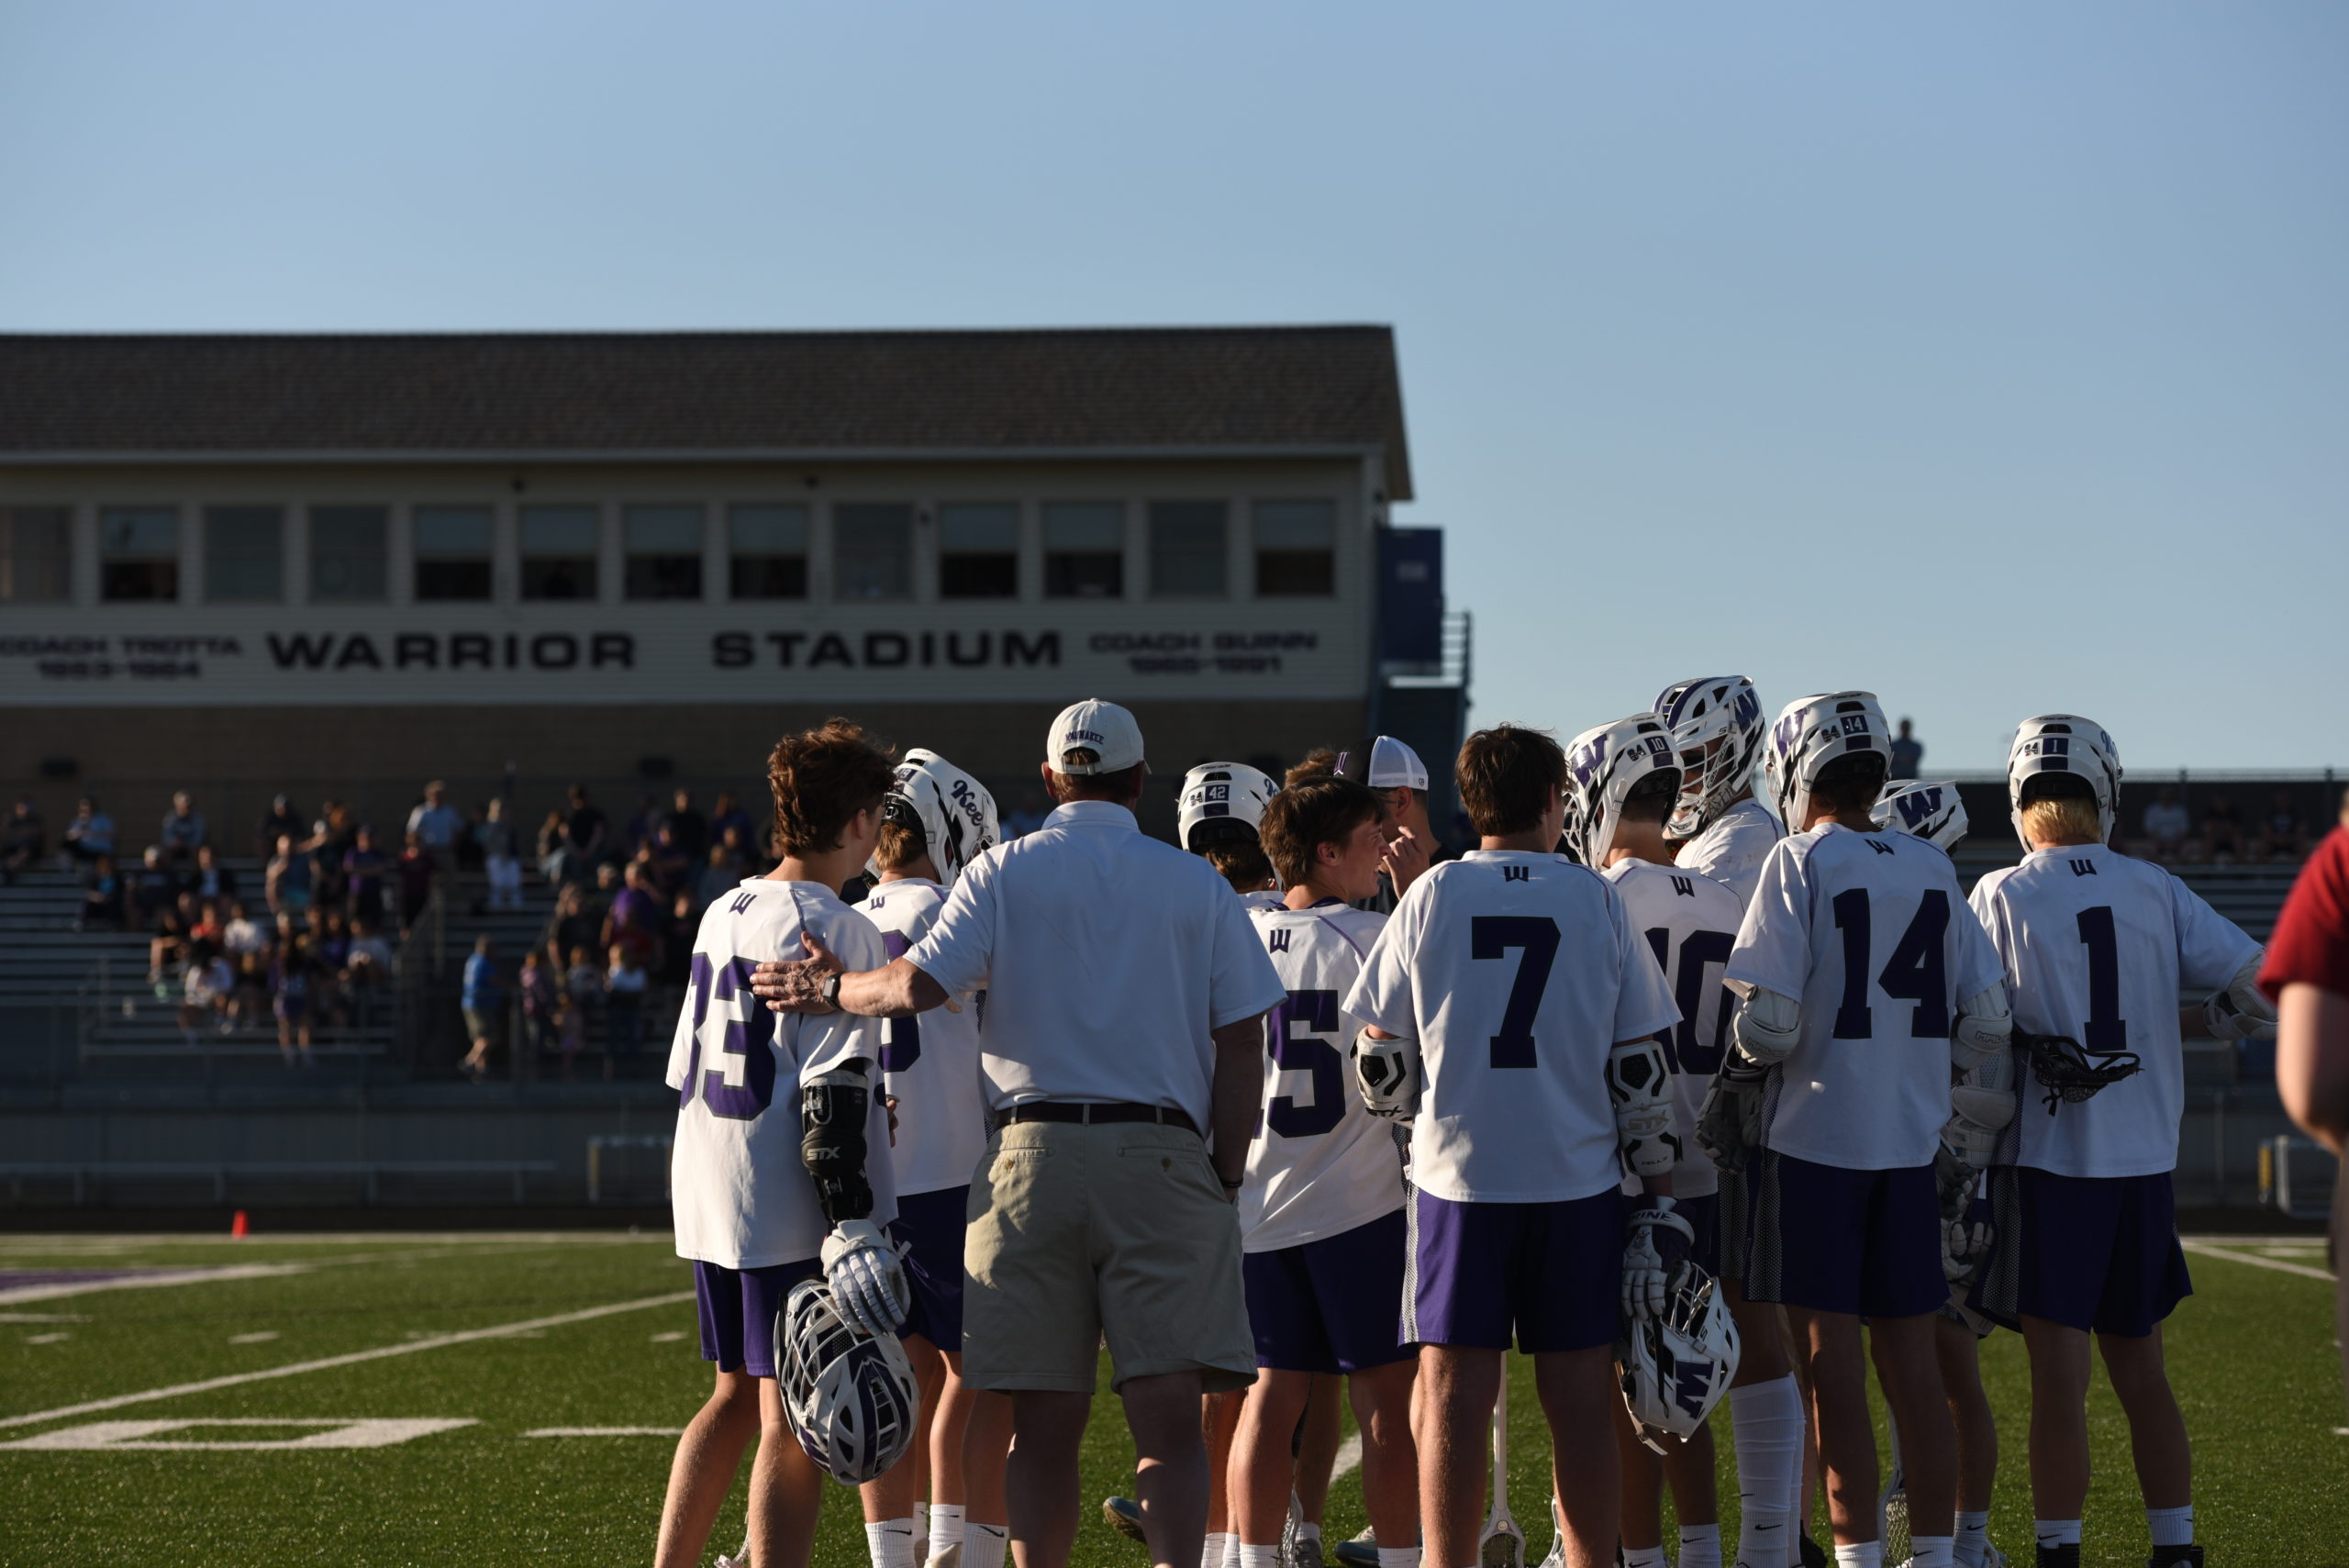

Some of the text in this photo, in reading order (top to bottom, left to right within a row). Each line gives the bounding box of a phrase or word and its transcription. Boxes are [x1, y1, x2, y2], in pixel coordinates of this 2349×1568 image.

[265, 631, 1062, 671] WARRIOR STADIUM
[1087, 632, 1199, 652] COACH
[1650, 737, 1664, 751] 10
[1208, 786, 1227, 801] 42
[1896, 787, 1943, 830] W
[1503, 866, 1530, 883] W
[1669, 874, 1696, 897] W
[1269, 929, 1291, 954] W
[1832, 887, 1951, 1040] 14
[2076, 906, 2127, 1051] 1
[1471, 916, 1562, 1069] 7
[1252, 989, 1346, 1139] 5
[807, 1146, 841, 1162] STX
